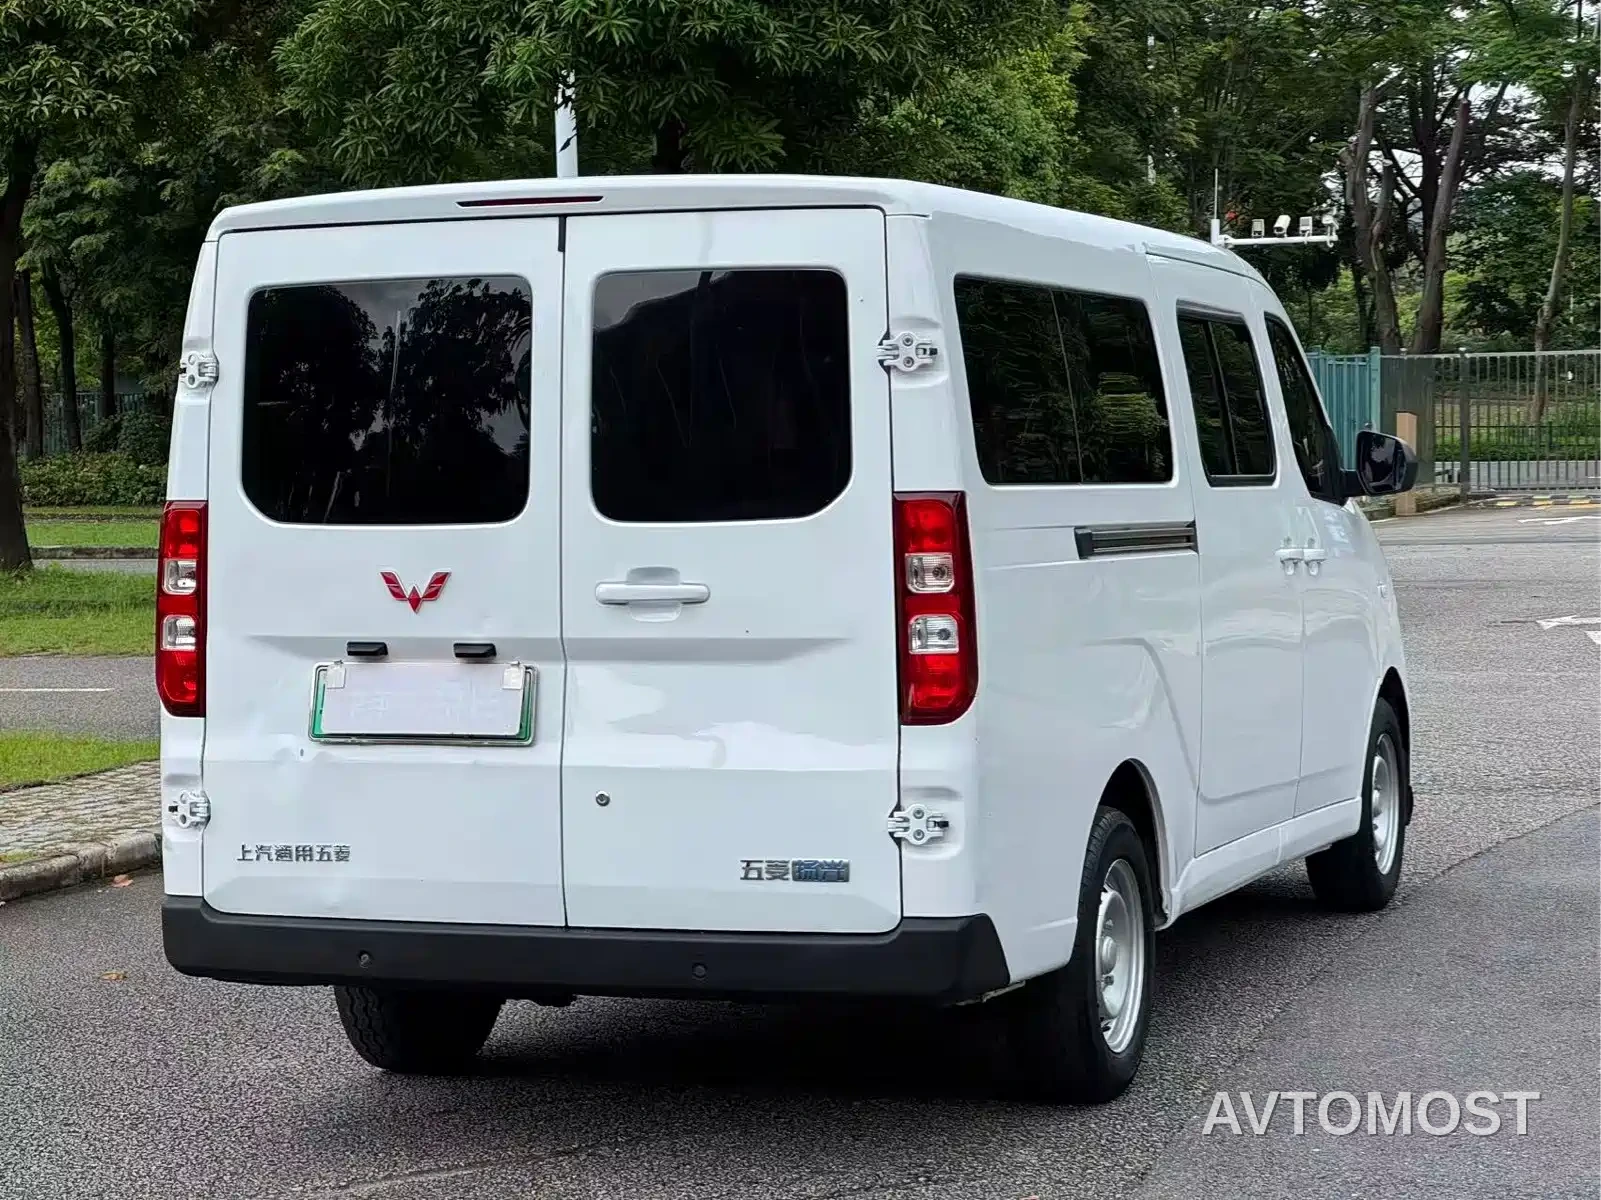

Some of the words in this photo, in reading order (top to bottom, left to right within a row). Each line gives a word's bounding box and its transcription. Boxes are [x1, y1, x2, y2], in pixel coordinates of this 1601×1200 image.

[237, 844, 350, 862] 上汽通用五菱
